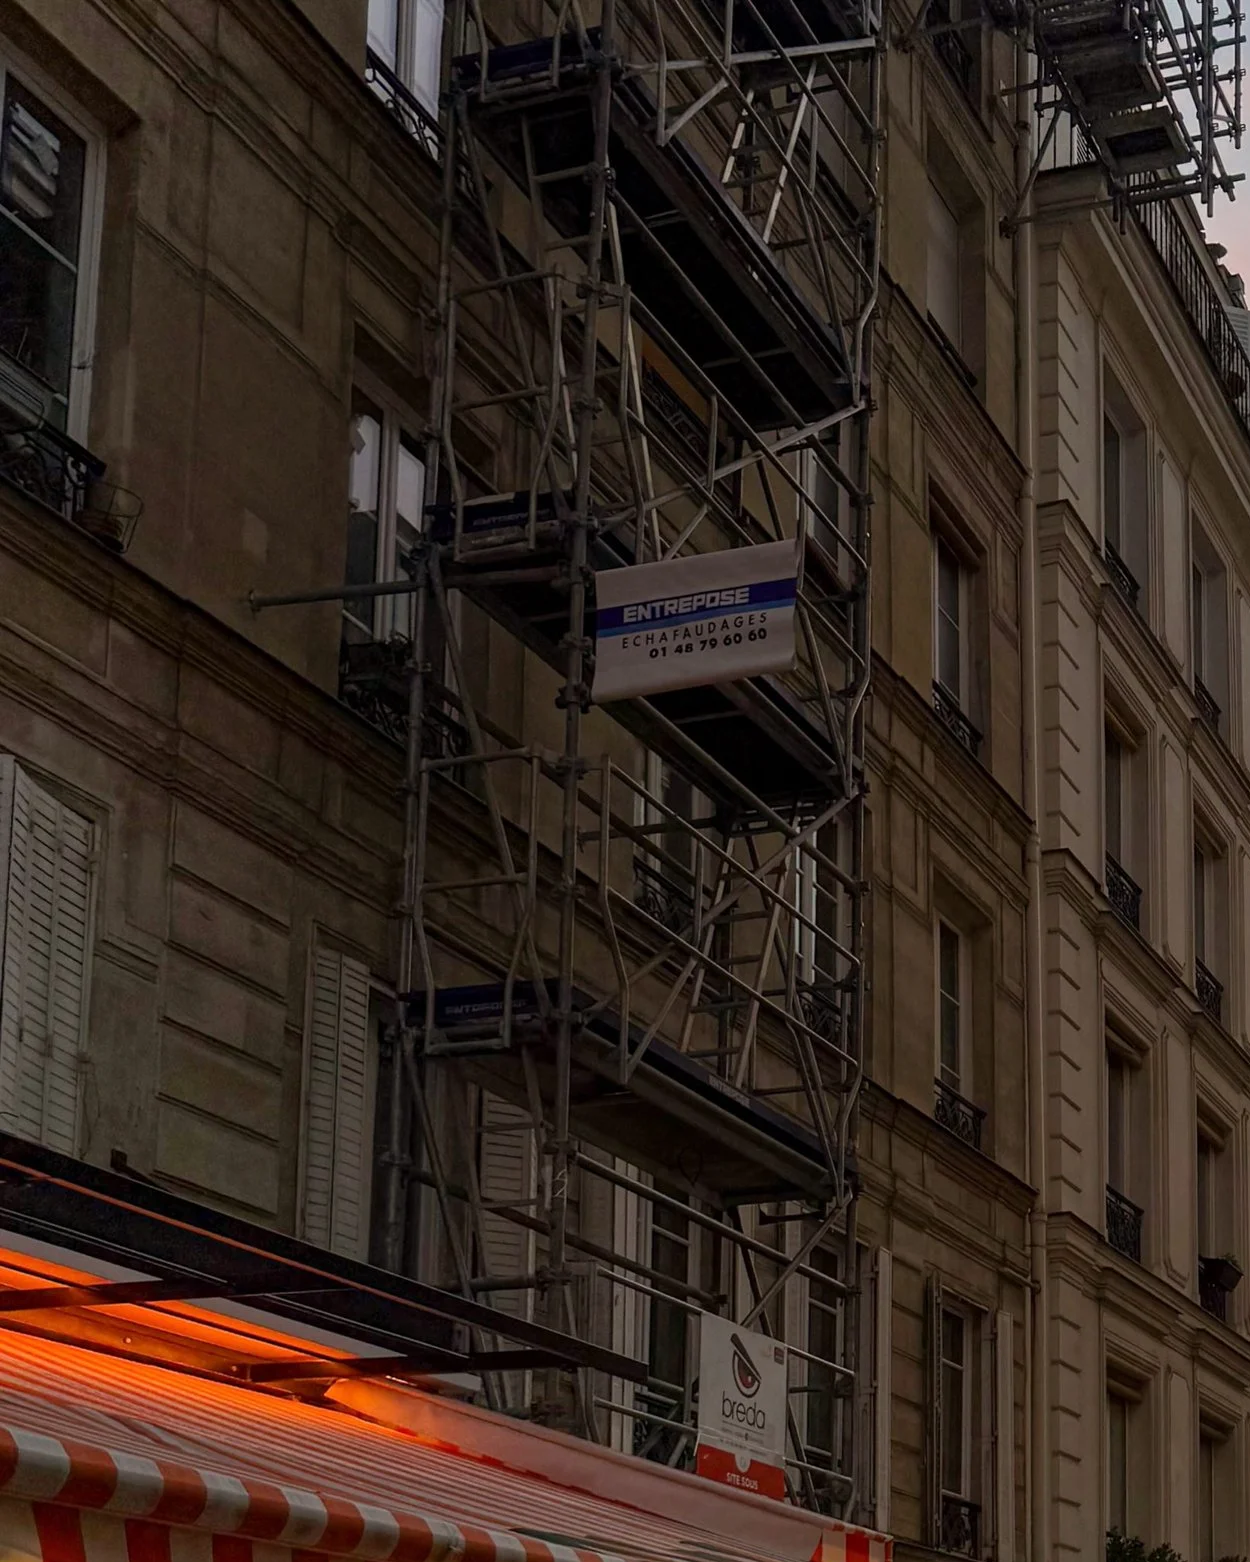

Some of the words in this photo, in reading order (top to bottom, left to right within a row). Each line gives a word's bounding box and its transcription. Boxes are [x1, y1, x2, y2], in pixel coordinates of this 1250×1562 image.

[623, 587, 750, 623] ENTREPOSE
[622, 612, 767, 649] ECHAFAUDAGES
[649, 647, 667, 658] 01
[674, 643, 693, 654] 48
[700, 638, 718, 651] 79
[723, 632, 742, 646] 60
[748, 628, 767, 641] 60
[722, 1390, 766, 1429] breda
[726, 1472, 741, 1485] SITE
